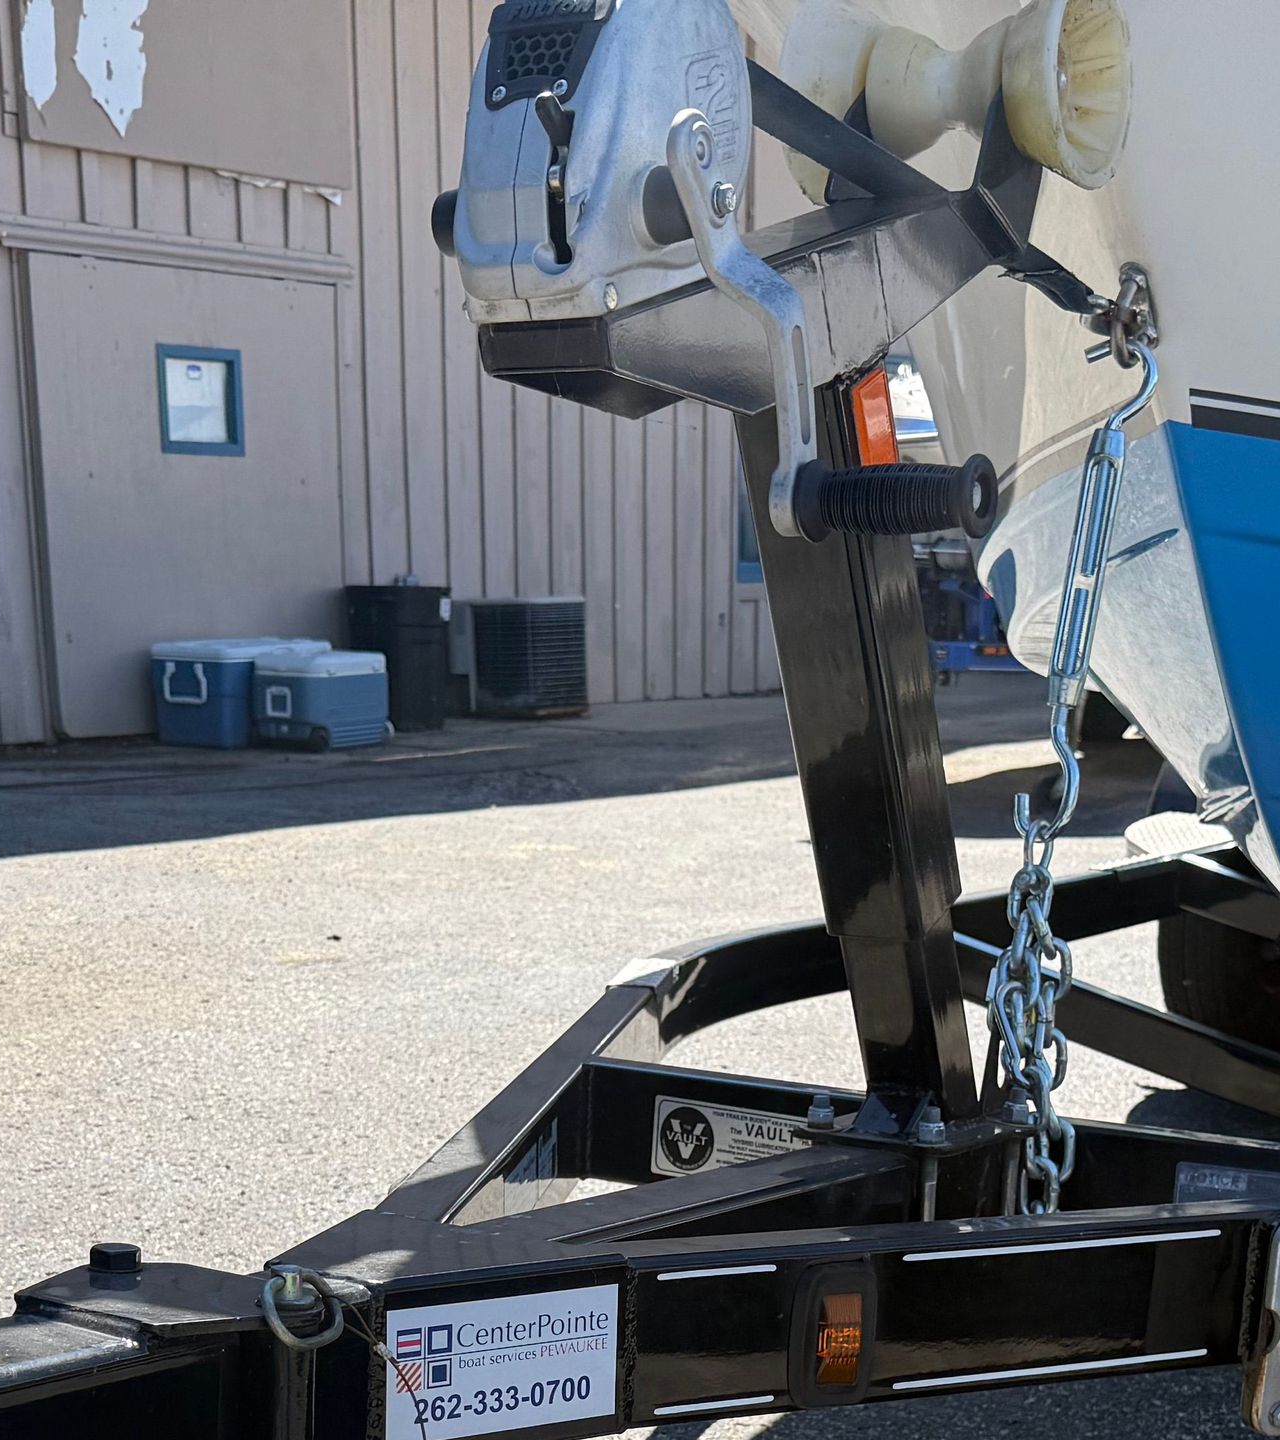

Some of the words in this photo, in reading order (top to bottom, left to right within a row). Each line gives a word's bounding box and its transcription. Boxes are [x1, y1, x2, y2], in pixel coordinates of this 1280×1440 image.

[666, 1130, 708, 1145] VAULT
[730, 1127, 742, 1135] The
[745, 1123, 795, 1144] VAULT
[457, 1310, 609, 1348] CenterPointe
[458, 1356, 486, 1369] boat
[489, 1350, 537, 1364] services
[540, 1337, 608, 1358] PEWAUKEE
[414, 1375, 591, 1425] 262-333-0700
